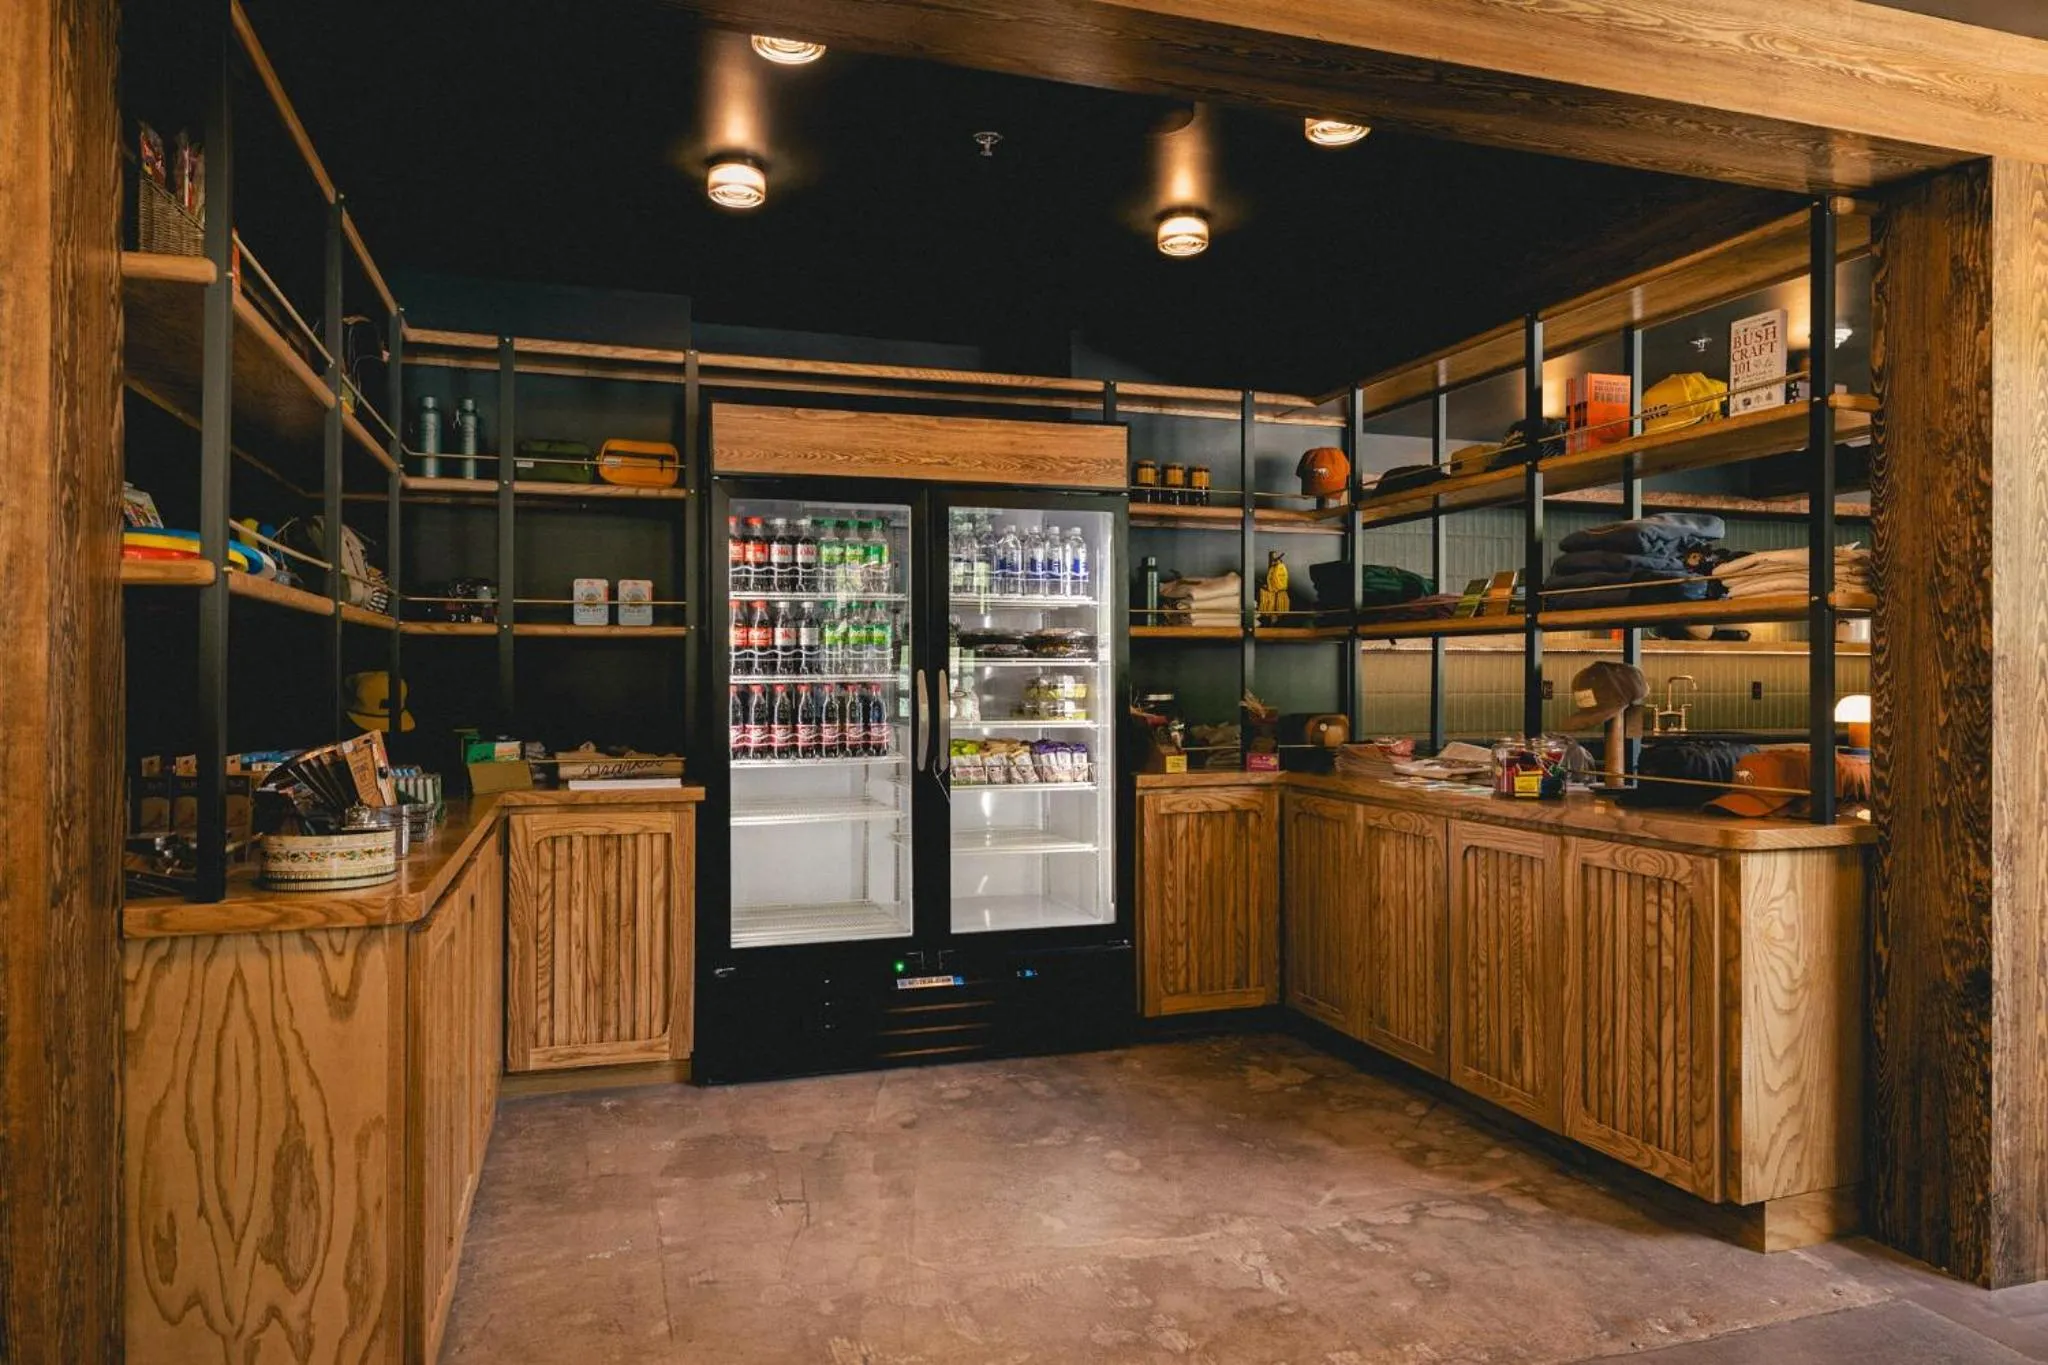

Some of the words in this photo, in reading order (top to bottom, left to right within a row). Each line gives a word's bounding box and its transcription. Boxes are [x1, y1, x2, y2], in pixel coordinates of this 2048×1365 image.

[1733, 326, 1777, 349] BUSH
[1732, 341, 1777, 362] CRAFT
[1734, 361, 1750, 376] 101
